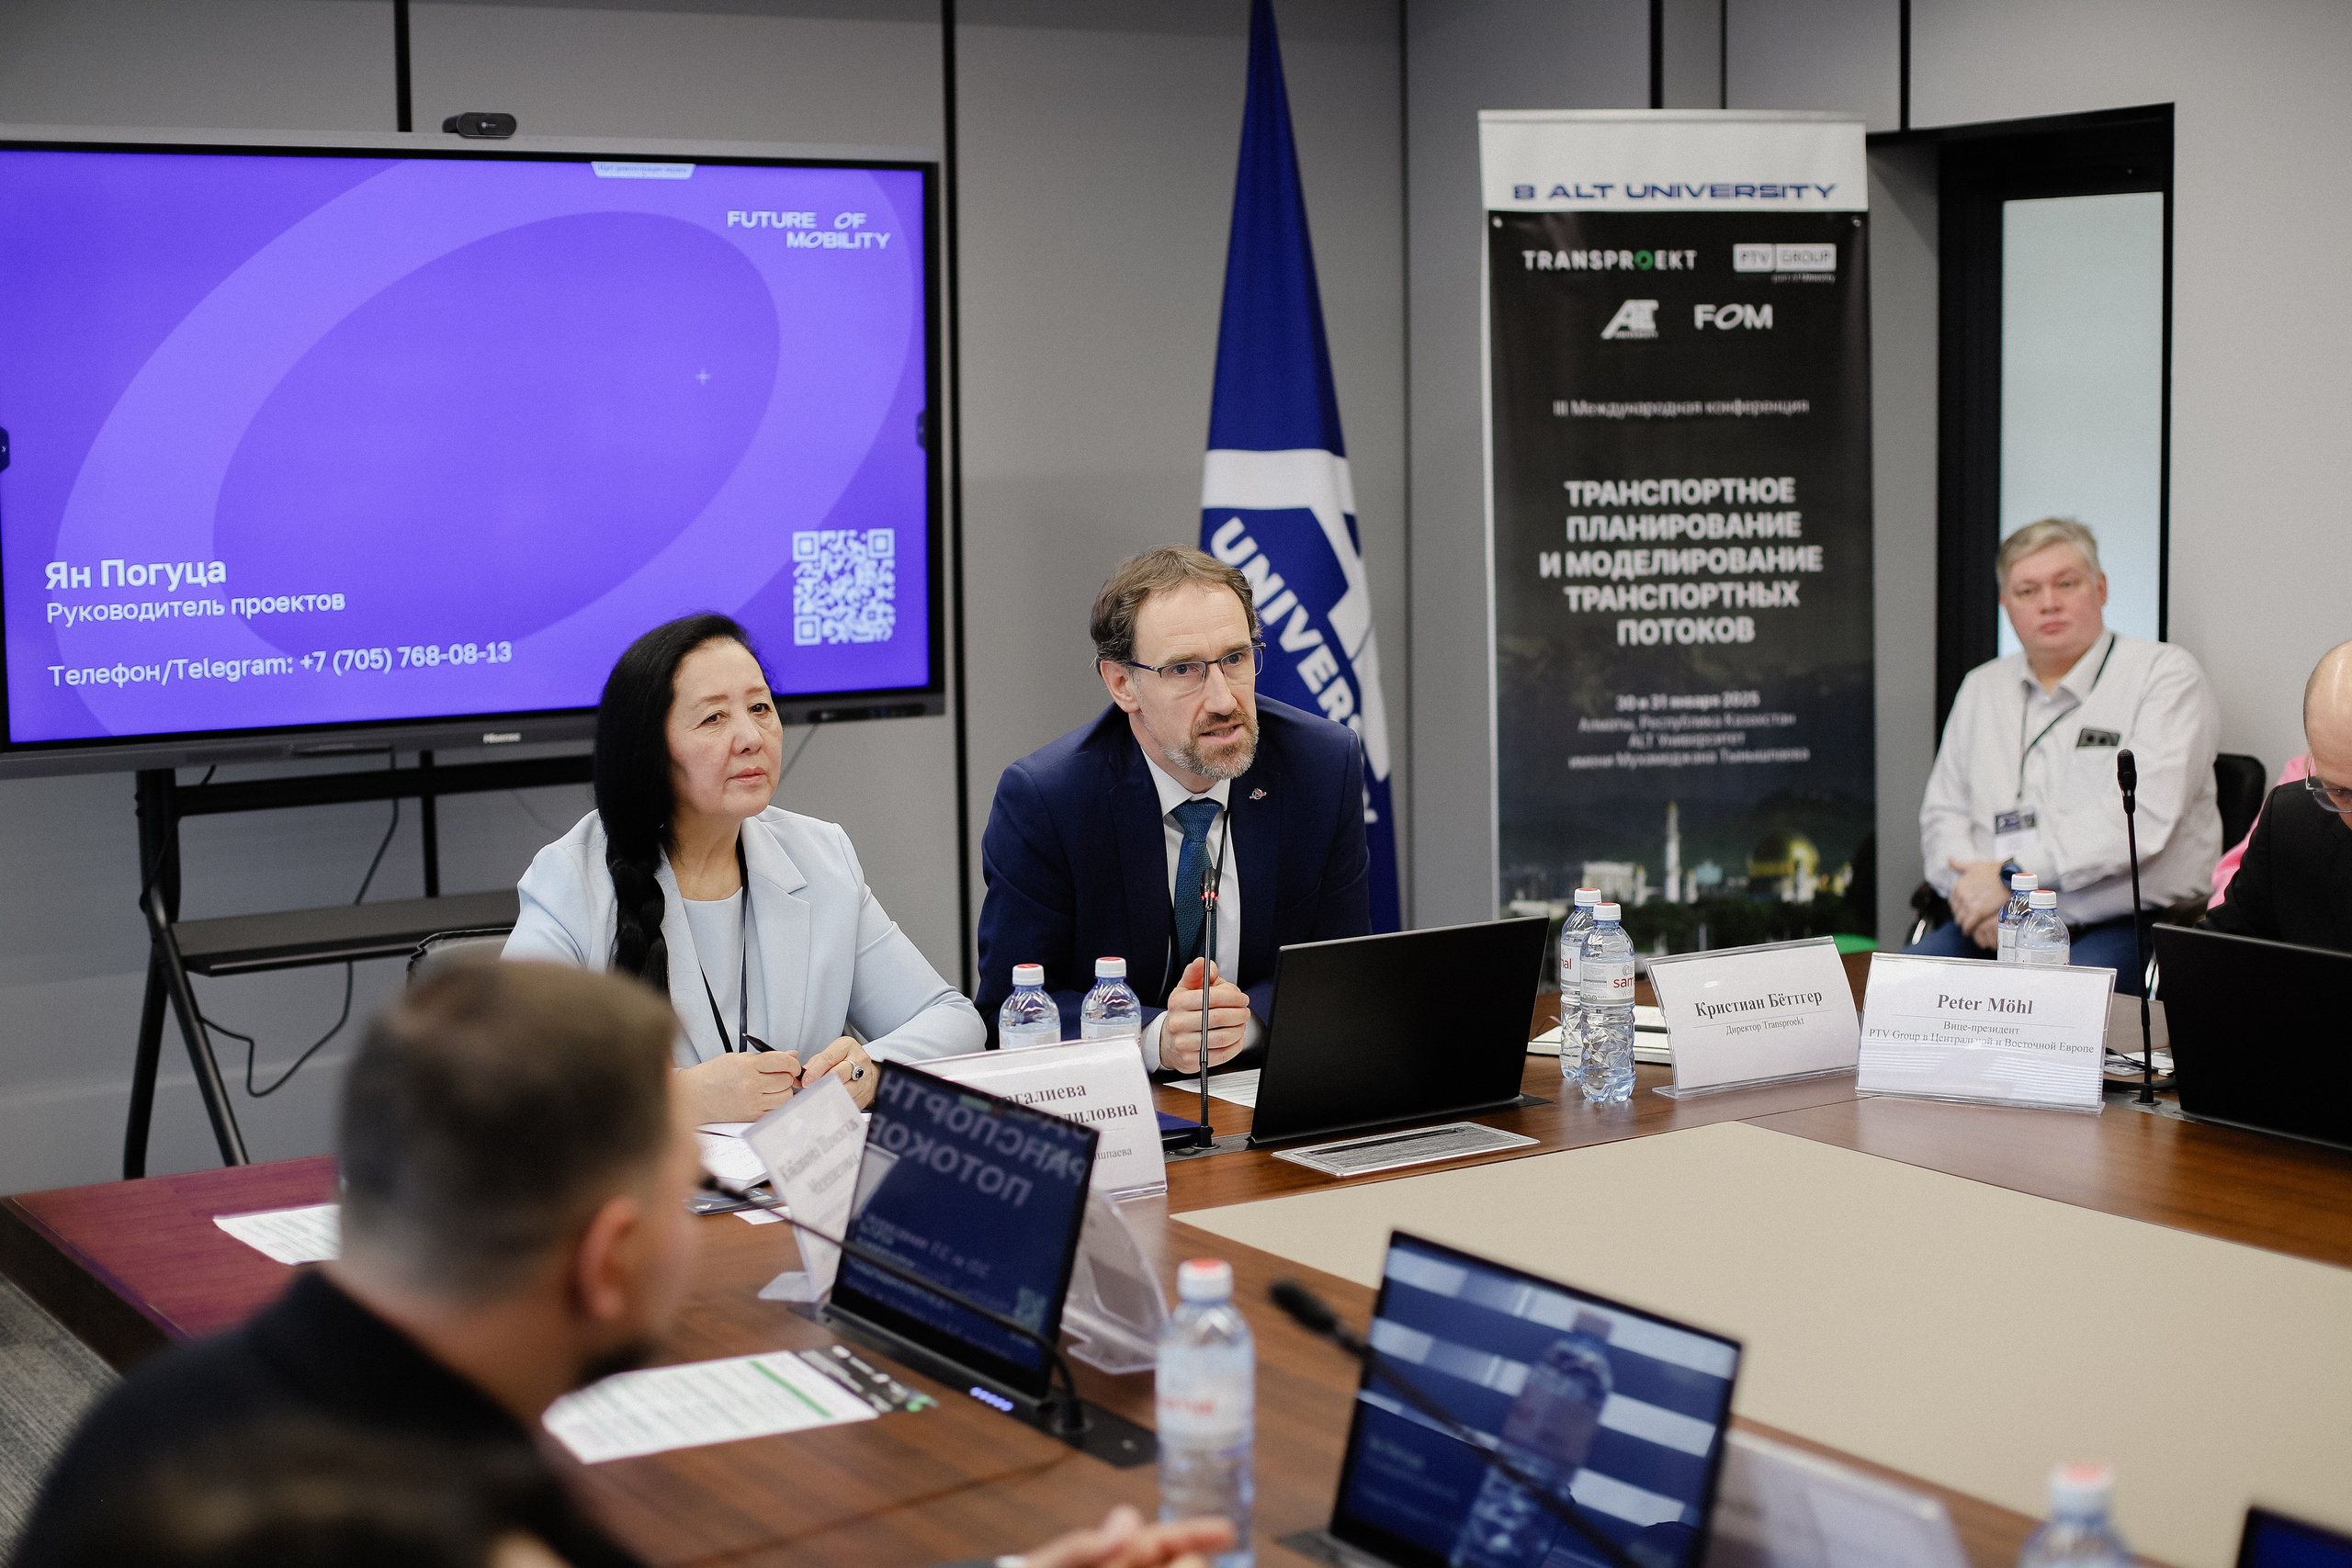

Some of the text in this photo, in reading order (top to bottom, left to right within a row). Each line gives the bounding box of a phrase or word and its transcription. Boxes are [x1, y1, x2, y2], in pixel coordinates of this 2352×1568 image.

[1549, 185, 1614, 198] ALT
[1626, 184, 1837, 198] UNIVERSITY
[727, 209, 867, 230] FUTURE OF
[786, 231, 891, 250] MOBILITY
[1521, 250, 1698, 271] TRANSPROEKT
[1694, 303, 1773, 331] FOM
[1564, 477, 1796, 506] ТРАНСПОРТНОЕ
[1566, 511, 1802, 542] ПЛАНИРОВАНИЕ
[45, 558, 227, 592] Ян Погуца
[1539, 546, 1824, 581] И МОДЕЛИРОВАНИЕ
[46, 592, 346, 628] Руководитель проектов
[1564, 581, 1800, 613] ТРАНСПОРТНЫХ
[1617, 616, 1756, 646] ПОТОКОВ
[47, 640, 513, 689] Телефон/Telegram: +7 (705) 768-08-13
[1694, 991, 1823, 1019] Кристиан Бёттгер
[1937, 994, 2033, 1014] Peter Möhl
[1726, 1016, 1804, 1035] Директор Transproekt
[1943, 1021, 2020, 1035] Вице-президент
[1869, 1029, 1889, 1039] PTV
[1893, 1030, 1921, 1043] Group
[1995, 1038, 2001, 1046] и
[2005, 1039, 2056, 1050] Восточной
[2059, 1042, 2094, 1054] Европе
